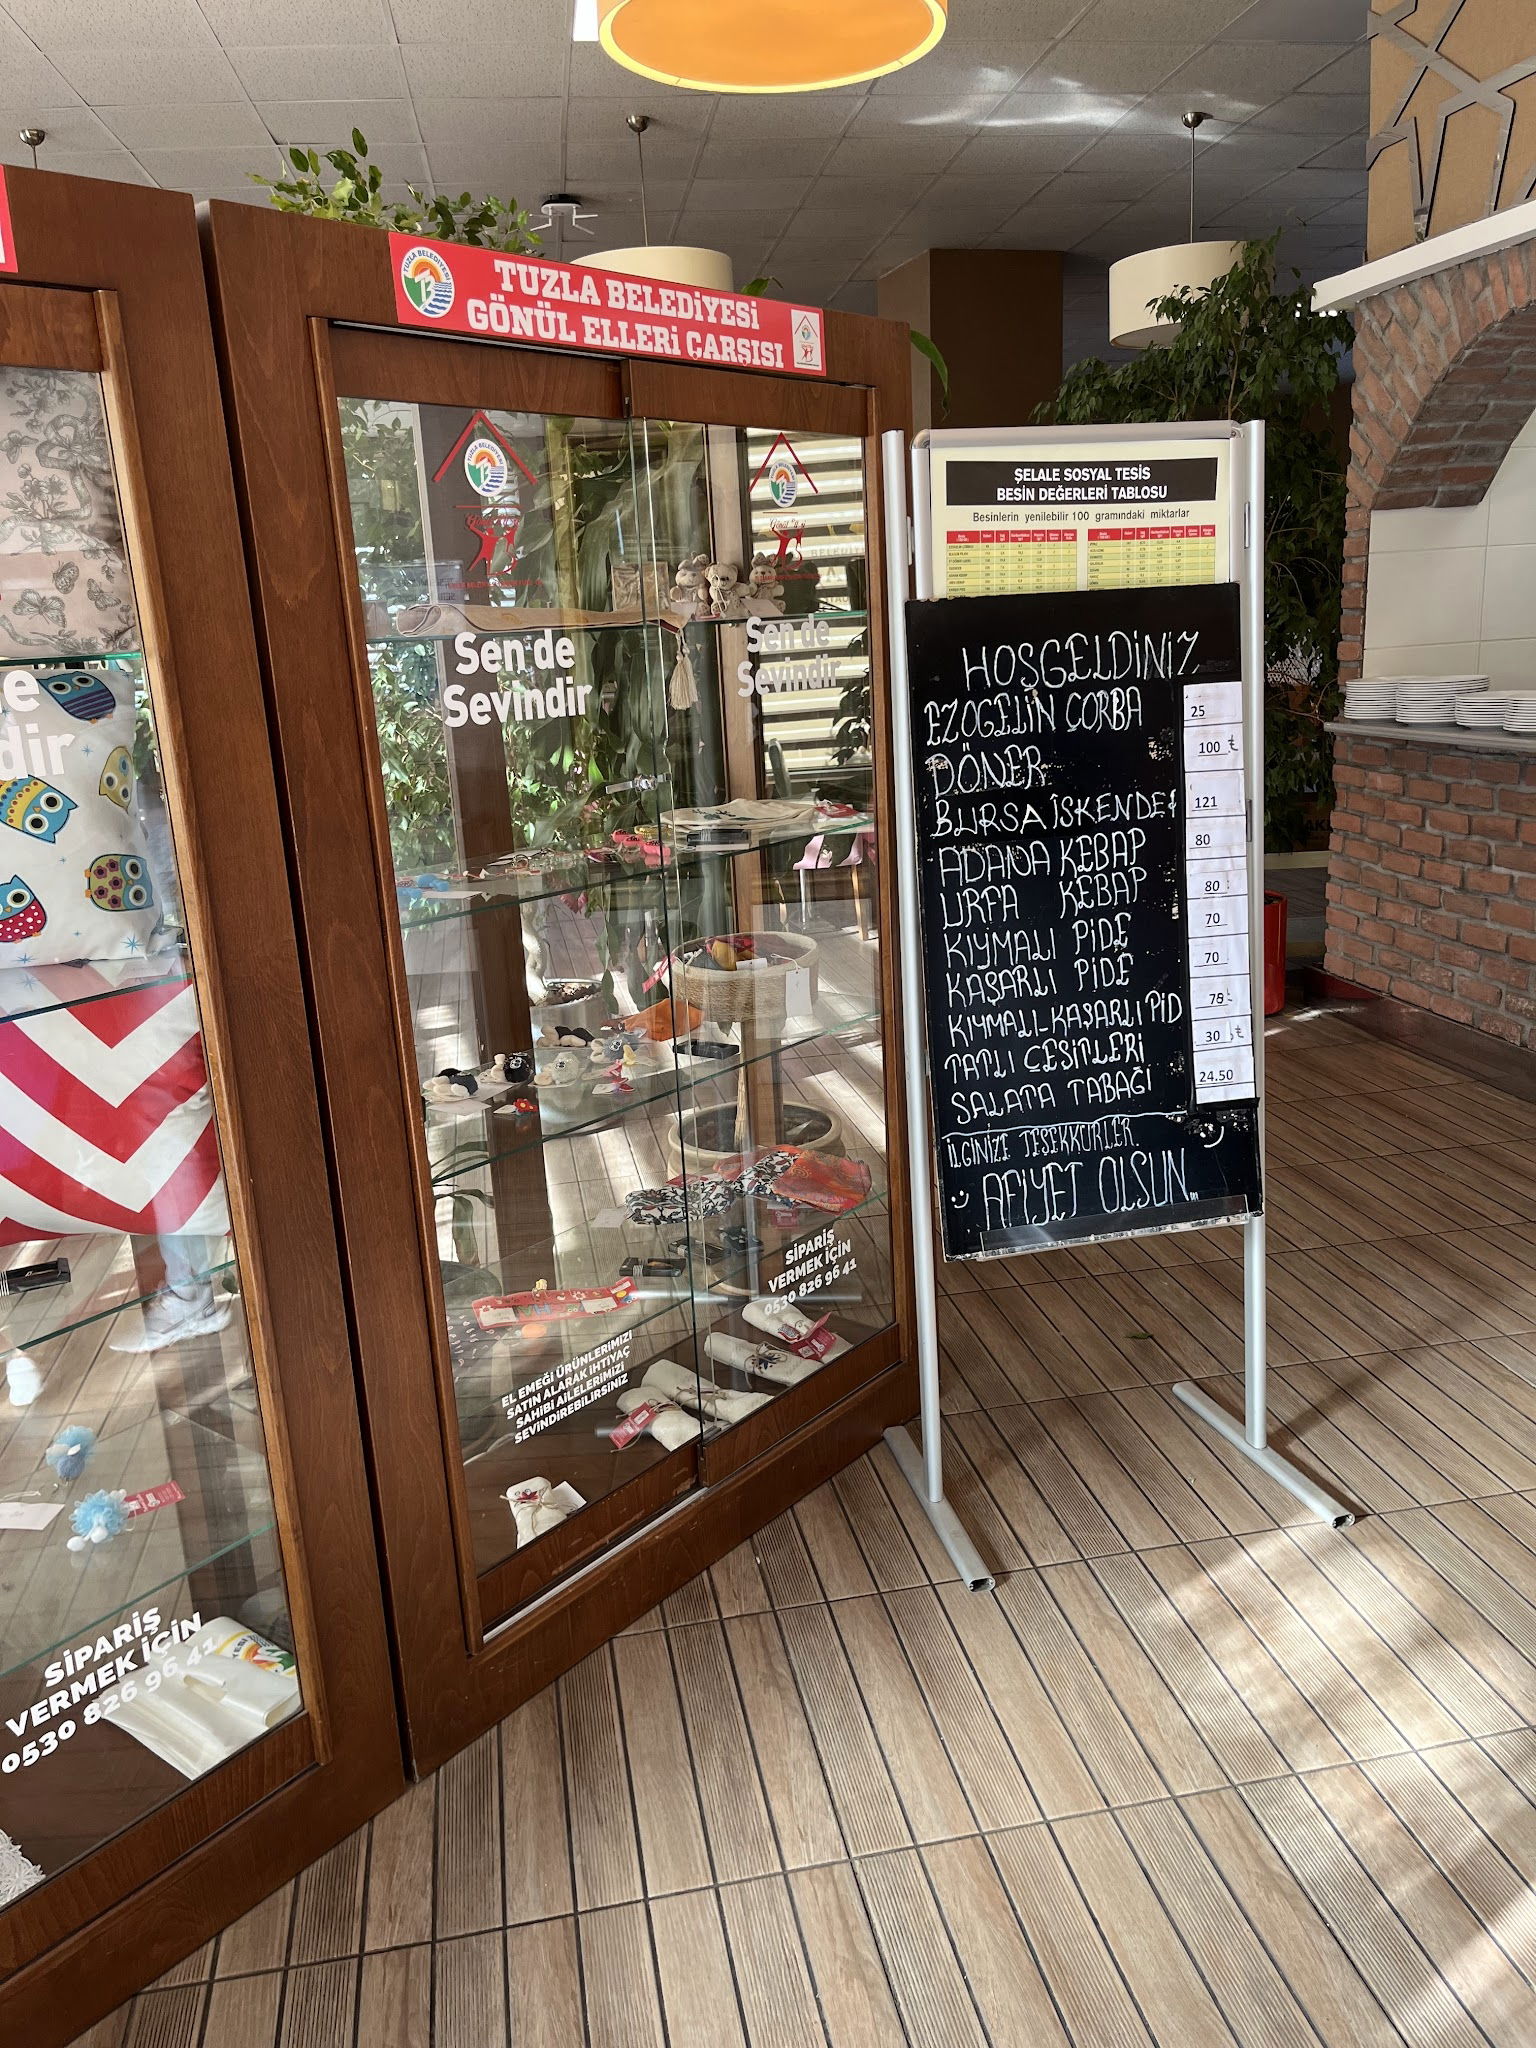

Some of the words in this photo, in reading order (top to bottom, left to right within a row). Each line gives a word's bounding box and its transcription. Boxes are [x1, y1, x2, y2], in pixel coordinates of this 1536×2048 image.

[494, 259, 601, 306] TUZLA
[467, 292, 577, 342] GÖNÜL
[686, 331, 784, 368] ÇARŞISI
[996, 485, 1034, 501] BESİN
[1037, 483, 1108, 500] DEĞERLERİ
[1111, 485, 1168, 500] TABLOSU
[1014, 467, 1060, 484] ŞELALE
[1063, 466, 1112, 482] SOSYAL
[1115, 464, 1151, 480] TESİS
[973, 511, 1019, 522] Besinlerin
[1025, 510, 1069, 525] yenilebilir
[1072, 511, 1090, 521] 100
[1095, 509, 1145, 523] gramındaki
[1150, 508, 1190, 520] miktarlar
[455, 632, 526, 675] Sen
[534, 629, 576, 670] de
[747, 617, 797, 653] Sen
[800, 613, 830, 647] de
[737, 655, 841, 698] Sevindir
[443, 678, 592, 727] Sevindir
[1066, 686, 1142, 733] ÇORBA
[1190, 705, 1205, 718] 25
[1199, 741, 1220, 754] 100
[925, 742, 1046, 800] DÖNER
[930, 800, 1047, 838] BURSA
[1194, 796, 1217, 809] 121
[939, 840, 1050, 887] ADANA
[1060, 827, 1146, 878] KEBAP
[1195, 833, 1210, 846] 80
[940, 884, 1019, 930] URFA
[1059, 867, 1147, 919] KEBAP
[1204, 880, 1220, 892] 80
[1072, 912, 1132, 955] PİDE
[1205, 912, 1220, 925] 70
[1074, 952, 1134, 991] PİDE
[1204, 952, 1219, 964] 70
[1205, 1030, 1220, 1042] 30
[944, 1048, 1015, 1084] TATLI
[1199, 1069, 1234, 1083] 24.50
[950, 1083, 1057, 1124] SALATA
[768, 1253, 823, 1293] VERMEK
[825, 1238, 852, 1265] İÇİN
[785, 1228, 835, 1266] SİPARİŞ
[764, 1290, 796, 1316] 0530
[799, 1274, 823, 1297] 826
[824, 1264, 840, 1286] 96
[842, 1257, 857, 1276] 41
[501, 1393, 517, 1408] EL
[518, 1373, 553, 1400] EMEĞİ
[507, 1392, 541, 1420] SATIN
[543, 1371, 588, 1401] ALARAK
[516, 1399, 555, 1429] SAHİBİ
[44, 1606, 162, 1688] SİPARİŞ
[5, 1648, 138, 1738] VERMEK
[141, 1611, 203, 1664] İÇİN
[1, 1721, 77, 1774] 0530
[83, 1684, 138, 1725] 826
[148, 1659, 178, 1694] 96
[187, 1636, 218, 1667] 41
